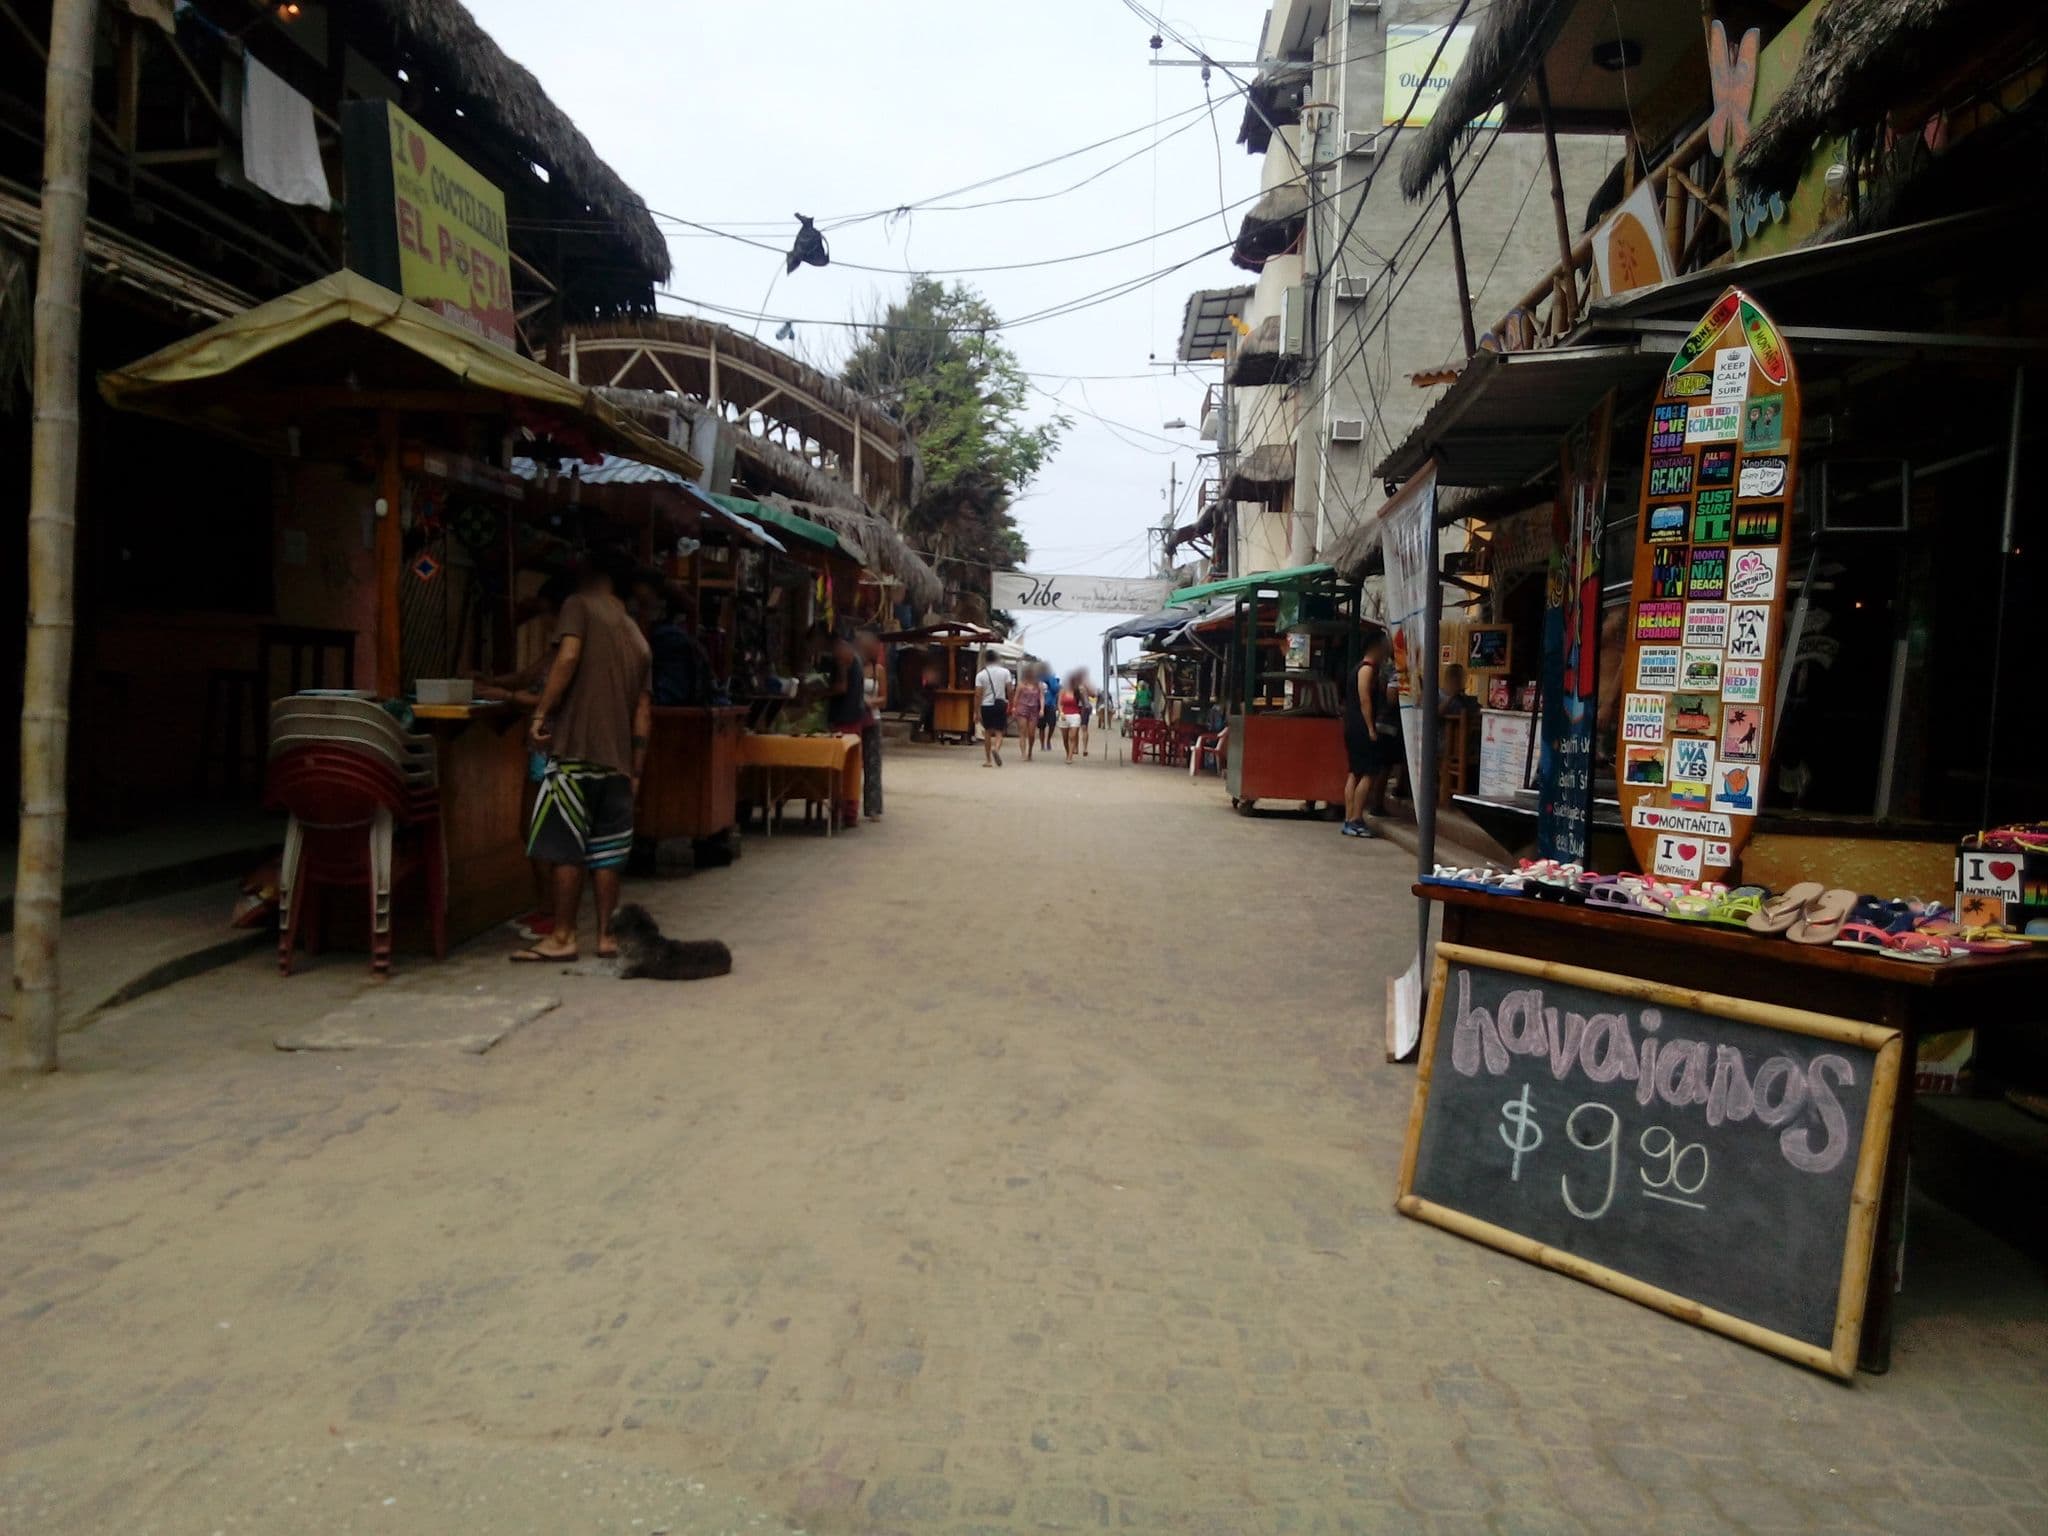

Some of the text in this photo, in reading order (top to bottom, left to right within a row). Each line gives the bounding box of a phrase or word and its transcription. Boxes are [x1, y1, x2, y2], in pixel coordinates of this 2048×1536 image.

[399, 196, 434, 265] EL
[1695, 324, 1711, 343] ONE
[1720, 362, 1745, 371] KEEP
[1717, 372, 1746, 381] CALM
[1718, 386, 1741, 395] SURF
[1687, 416, 1737, 433] ECUADOR
[1652, 433, 1684, 448] SURF
[1704, 452, 1718, 460] ALL
[1650, 466, 1692, 495] BEACH
[1698, 490, 1731, 504] JUST
[1697, 503, 1731, 515] SURF
[1693, 550, 1726, 561] MONTA
[1005, 574, 1063, 609] Vibe
[1690, 579, 1724, 590] BEACH
[1689, 590, 1722, 598] ECUADOR
[1638, 611, 1681, 628] BEACH
[1637, 628, 1680, 638] ECUADOR
[1728, 667, 1759, 677] ALL YOU
[1726, 677, 1747, 686] NEED
[1628, 698, 1664, 714] I'M IN
[1625, 723, 1661, 739] BITCH
[1679, 745, 1707, 762] WA
[1677, 761, 1707, 777] VES
[1638, 812, 1726, 835] I MONTAÑITA
[1662, 840, 1674, 859] I
[1657, 863, 1695, 877] MONTAÑITA
[1969, 858, 1984, 881] I
